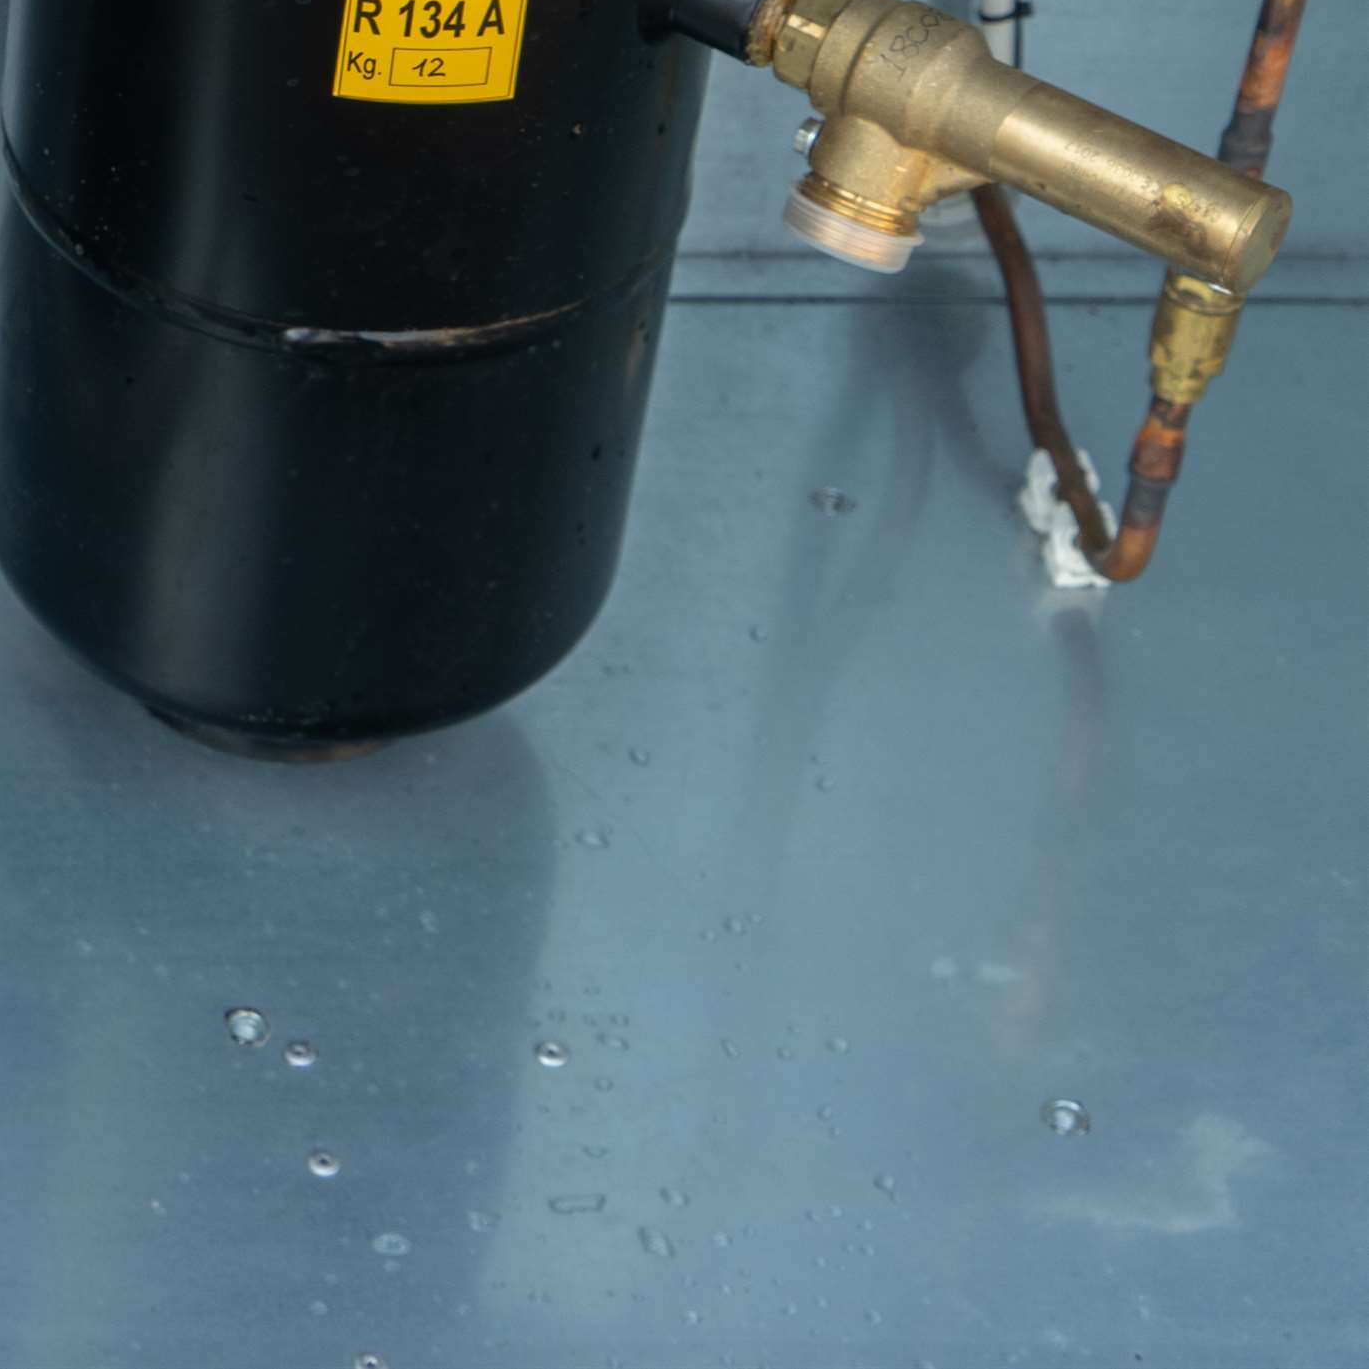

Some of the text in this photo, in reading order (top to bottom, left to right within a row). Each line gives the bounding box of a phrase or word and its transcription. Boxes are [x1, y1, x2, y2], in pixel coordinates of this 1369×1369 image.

[398, 0, 466, 39] 134
[347, 51, 382, 80] Kg.
[412, 57, 446, 77] 12
